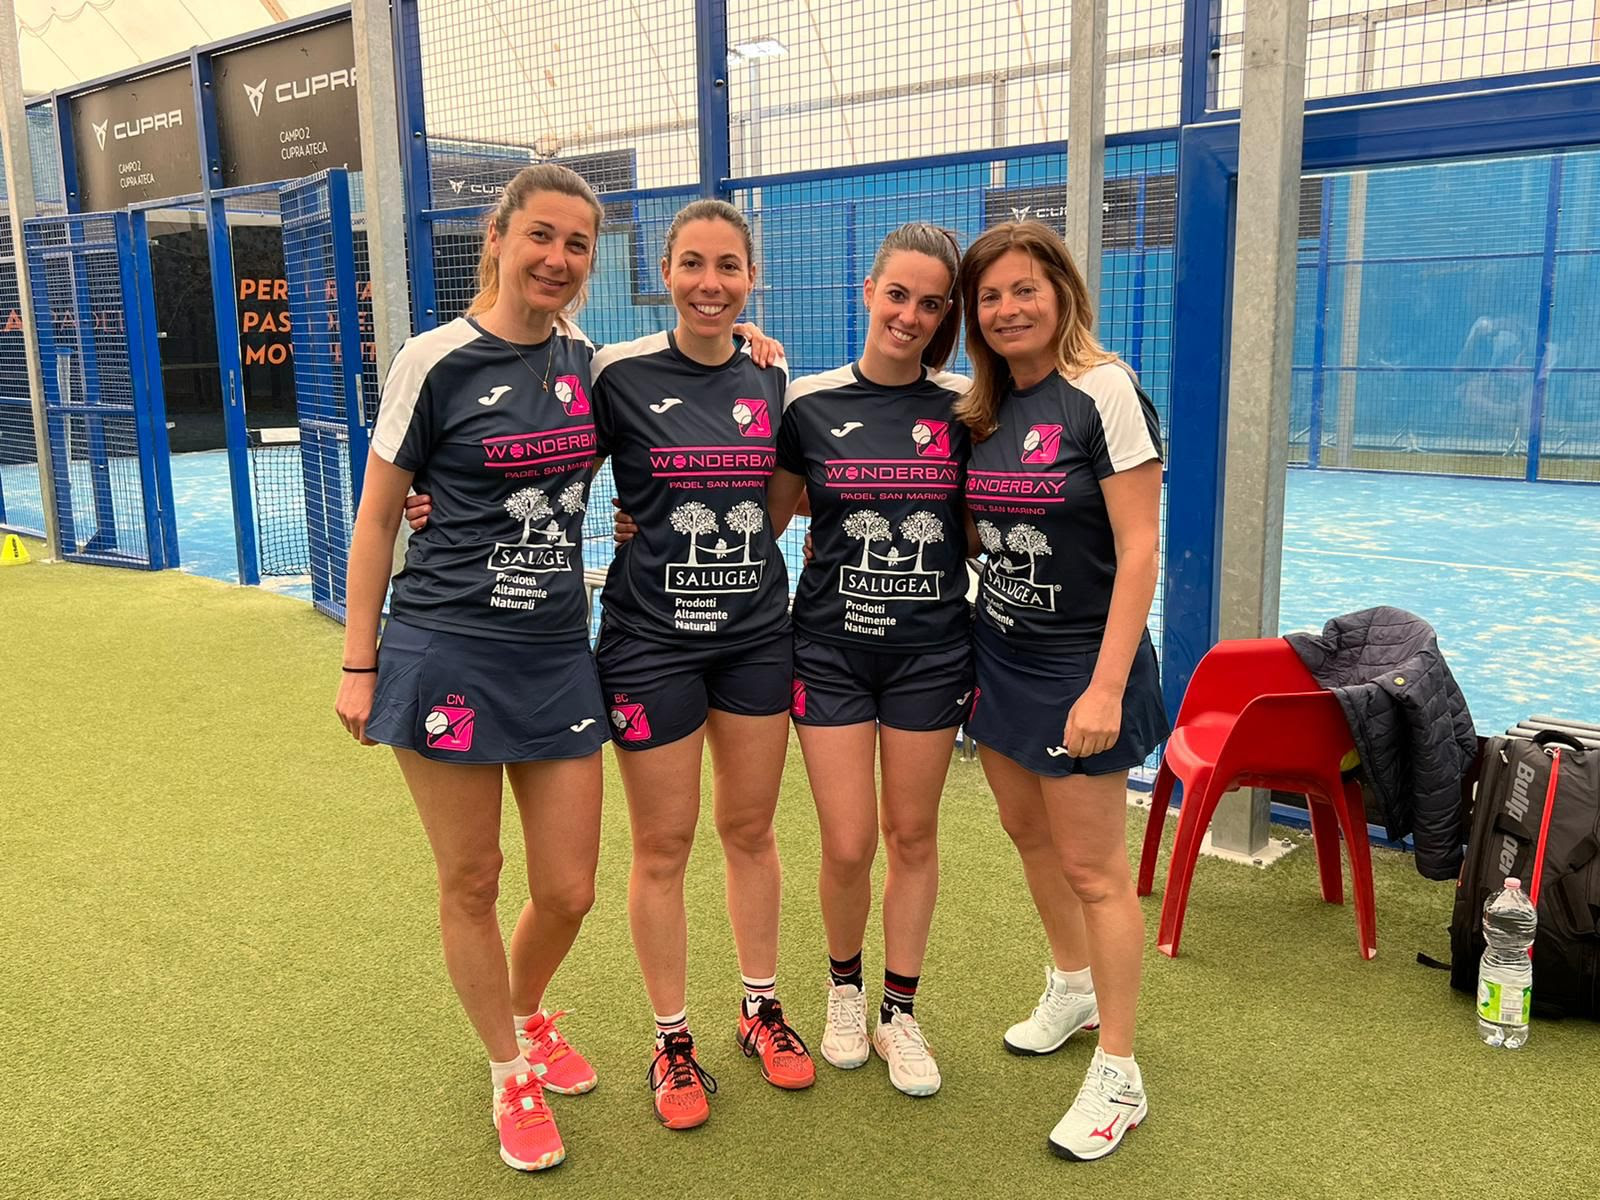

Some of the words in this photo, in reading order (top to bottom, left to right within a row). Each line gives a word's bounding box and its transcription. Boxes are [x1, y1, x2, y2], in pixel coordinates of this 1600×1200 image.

[114, 109, 183, 140] CUPRA
[279, 128, 305, 143] CAMPO
[305, 126, 311, 139] 2
[281, 145, 304, 160] CUPRA
[304, 141, 328, 156] ATECA
[118, 161, 137, 174] CAMPO
[120, 176, 137, 189] CUPRA
[137, 173, 155, 185] ATECA
[245, 343, 293, 365] MO
[484, 432, 597, 459] WONDERBA
[650, 454, 776, 469] WONDERBAY
[505, 470, 541, 479] PADEL
[544, 466, 565, 475] SAN
[826, 466, 958, 481] WONDERBAY
[669, 481, 703, 489] PADEL
[707, 480, 729, 488] SAN
[732, 480, 765, 488] MARIN
[840, 492, 875, 500] PADEL
[879, 492, 903, 500] SAN
[907, 492, 947, 500] MARINO
[1007, 506, 1046, 515] MARINO
[496, 572, 537, 586] Prodotti
[676, 570, 758, 586] SALUGEA
[849, 574, 931, 593] SALUGEA
[492, 584, 548, 599] Altamente
[988, 569, 1044, 605] SALUGEA
[490, 596, 535, 610] Naturali
[675, 597, 717, 608] Prodotti
[845, 600, 885, 614] Prodotti
[674, 609, 728, 620] Altamente
[845, 611, 897, 626] Altamente
[675, 620, 717, 632] Naturali
[844, 621, 885, 636] Naturali
[446, 694, 465, 705] CN
[614, 693, 629, 703] BC
